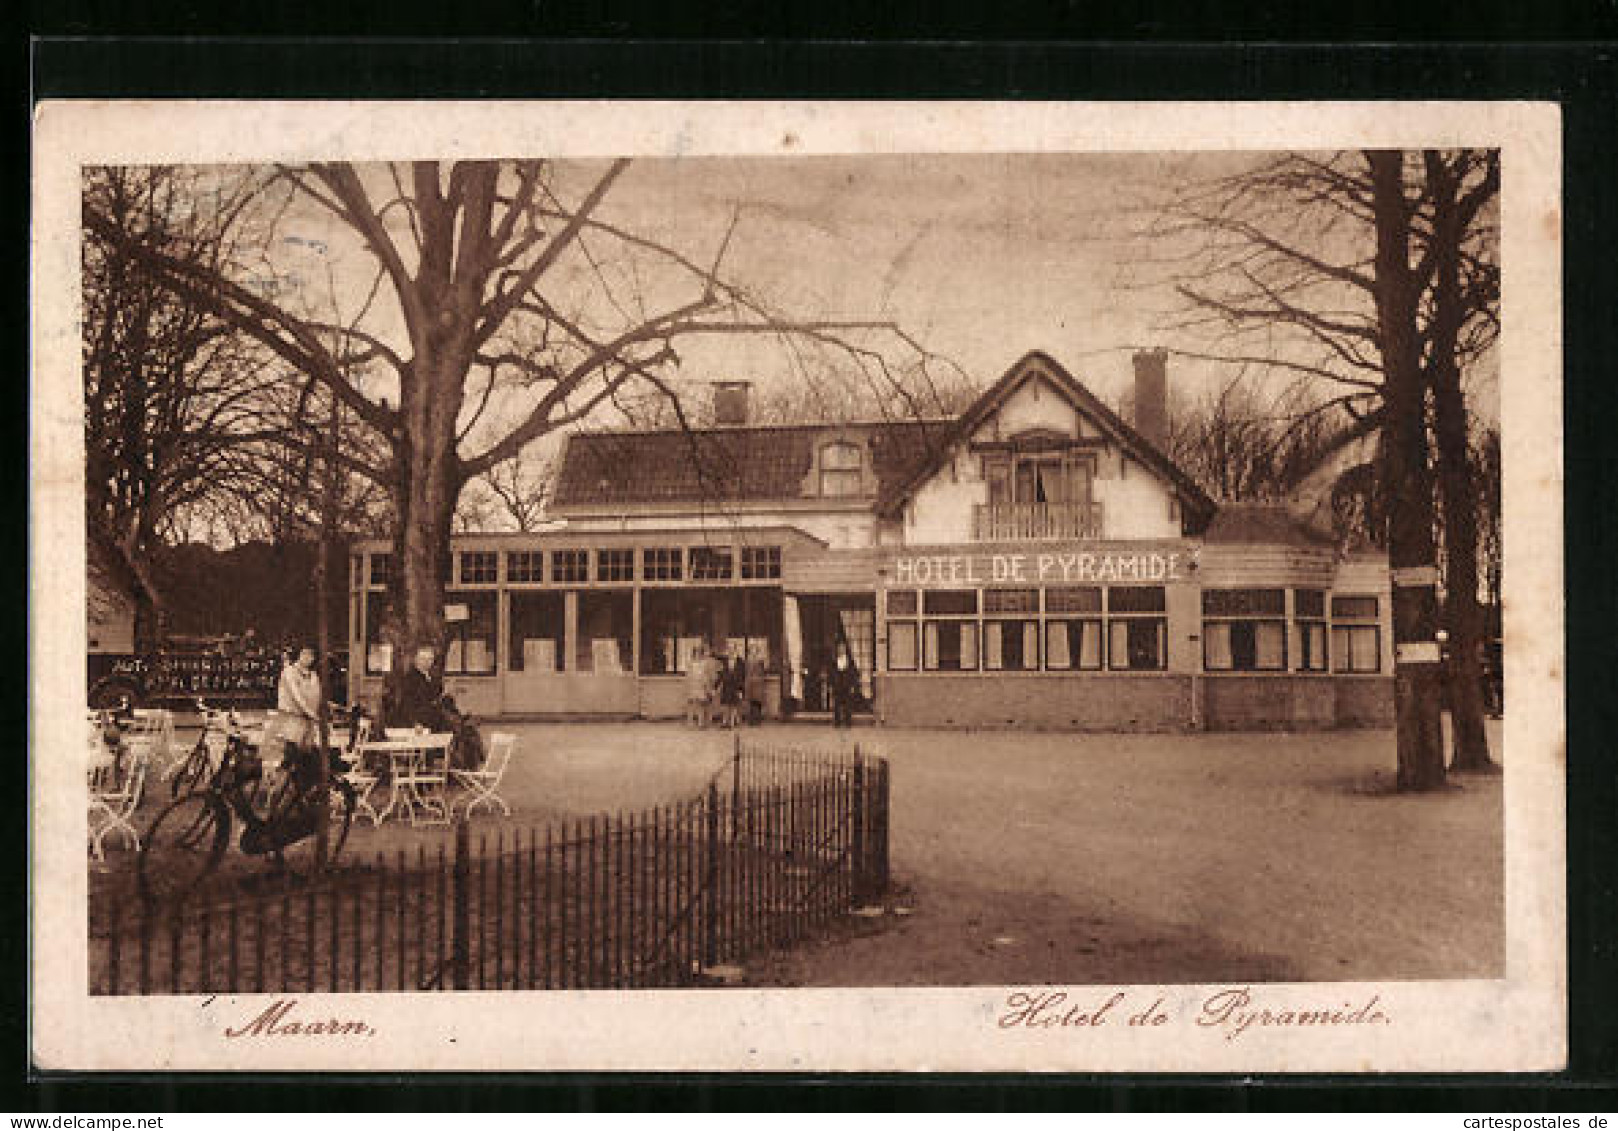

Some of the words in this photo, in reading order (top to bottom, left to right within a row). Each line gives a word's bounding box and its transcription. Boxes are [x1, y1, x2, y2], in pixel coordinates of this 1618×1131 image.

[898, 556, 982, 584] HOTEL
[992, 555, 1028, 582] DE
[1038, 553, 1182, 582] PYRAMIDE
